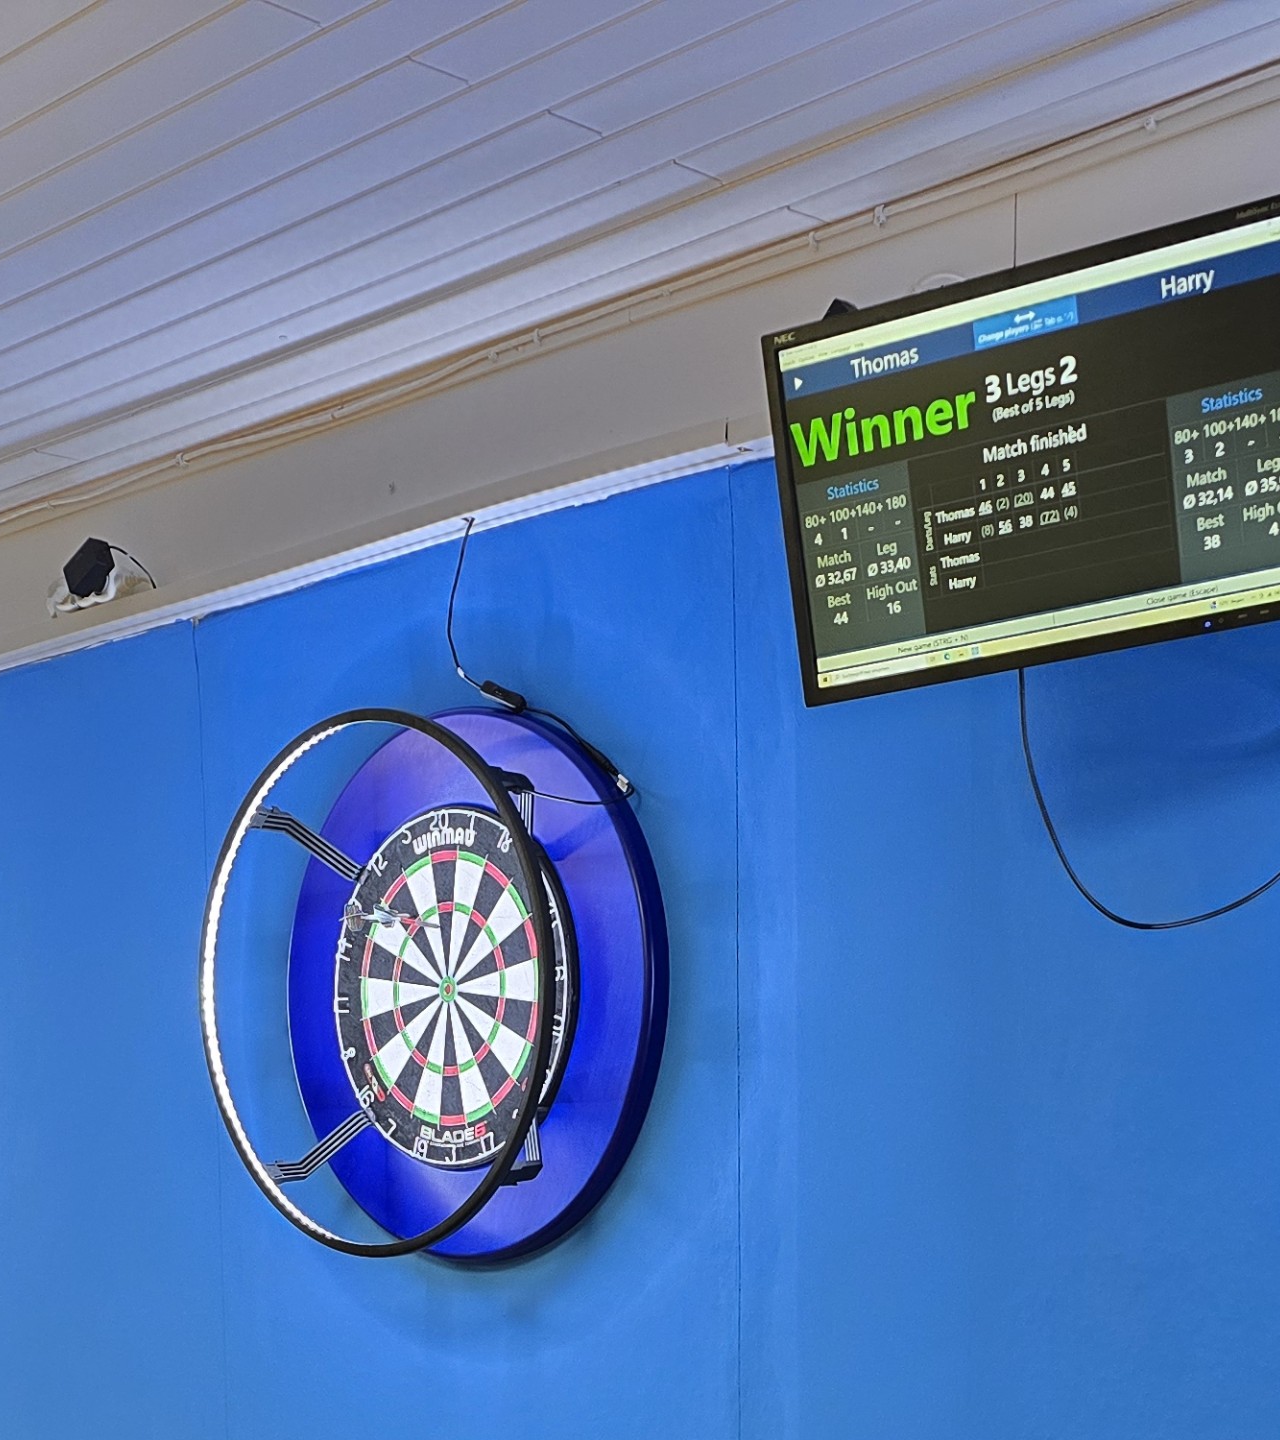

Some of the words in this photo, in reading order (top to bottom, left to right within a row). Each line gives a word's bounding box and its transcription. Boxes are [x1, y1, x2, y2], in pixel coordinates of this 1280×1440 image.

[1161, 270, 1215, 299] Harry
[774, 332, 796, 345] NEC
[850, 347, 919, 379] Thomas
[985, 374, 1002, 403] 3
[1006, 366, 1056, 396] Legs
[1059, 355, 1078, 385] 2
[992, 403, 1020, 423] (Best
[1021, 398, 1034, 414] of
[1035, 396, 1044, 411] 5
[1045, 389, 1075, 409] Legs)
[1201, 388, 1264, 414] Statistics
[790, 391, 976, 467] Winner
[1174, 429, 1200, 445] 80+
[1203, 421, 1235, 438] 100+
[1234, 413, 1266, 431] 140+
[983, 438, 1028, 463] Match
[1030, 423, 1087, 452] finished
[1184, 449, 1194, 465] 3
[1215, 442, 1225, 458] 2
[979, 478, 986, 490] 1
[996, 474, 1005, 487] 2
[1018, 469, 1026, 482] 3
[1041, 463, 1050, 476] 4
[1062, 458, 1071, 472] 5
[1186, 467, 1227, 489] Match
[827, 478, 880, 500] Statistics
[1198, 486, 1234, 507] 32,14
[805, 514, 826, 529] 80+
[830, 507, 856, 523] 100+
[856, 501, 883, 517] 140+
[886, 494, 906, 510] 180
[935, 506, 976, 524] Thomas
[996, 497, 1009, 511] (2)
[1014, 492, 1034, 507] (20)
[1040, 486, 1055, 500] 44
[1061, 481, 1076, 497] 45
[944, 531, 972, 545] Harry
[981, 525, 995, 538] (8)
[999, 520, 1013, 534] 56
[1019, 515, 1033, 529] 38
[1040, 510, 1060, 525] (72)
[1064, 506, 1078, 520] (4)
[1197, 513, 1224, 532] Best
[1243, 503, 1275, 523] High
[814, 533, 823, 546] 4
[841, 527, 848, 540] 1
[1204, 534, 1221, 550] 38
[1269, 521, 1280, 536] 4
[817, 550, 852, 569] Match
[877, 542, 897, 556] Leg
[880, 556, 911, 575] 33,40
[940, 552, 980, 569] Thomas
[828, 567, 857, 586] 32,67
[949, 576, 977, 590] Harry
[827, 593, 851, 608] Best
[866, 584, 893, 601] High
[895, 578, 918, 594] Out
[1146, 596, 1165, 605] Close
[1168, 591, 1187, 602] game
[1189, 585, 1218, 599] (Escape)
[833, 611, 849, 625] 44
[887, 600, 902, 614] 16
[898, 646, 912, 654] New
[914, 641, 931, 653] game
[429, 810, 449, 831] 20
[467, 811, 476, 832] 1
[402, 827, 412, 845] 5
[412, 827, 476, 855] WINMAU
[497, 825, 513, 853] 18
[370, 852, 389, 877] 12
[342, 1047, 356, 1060] 8
[385, 1118, 397, 1138] 7
[410, 1136, 428, 1159] 19
